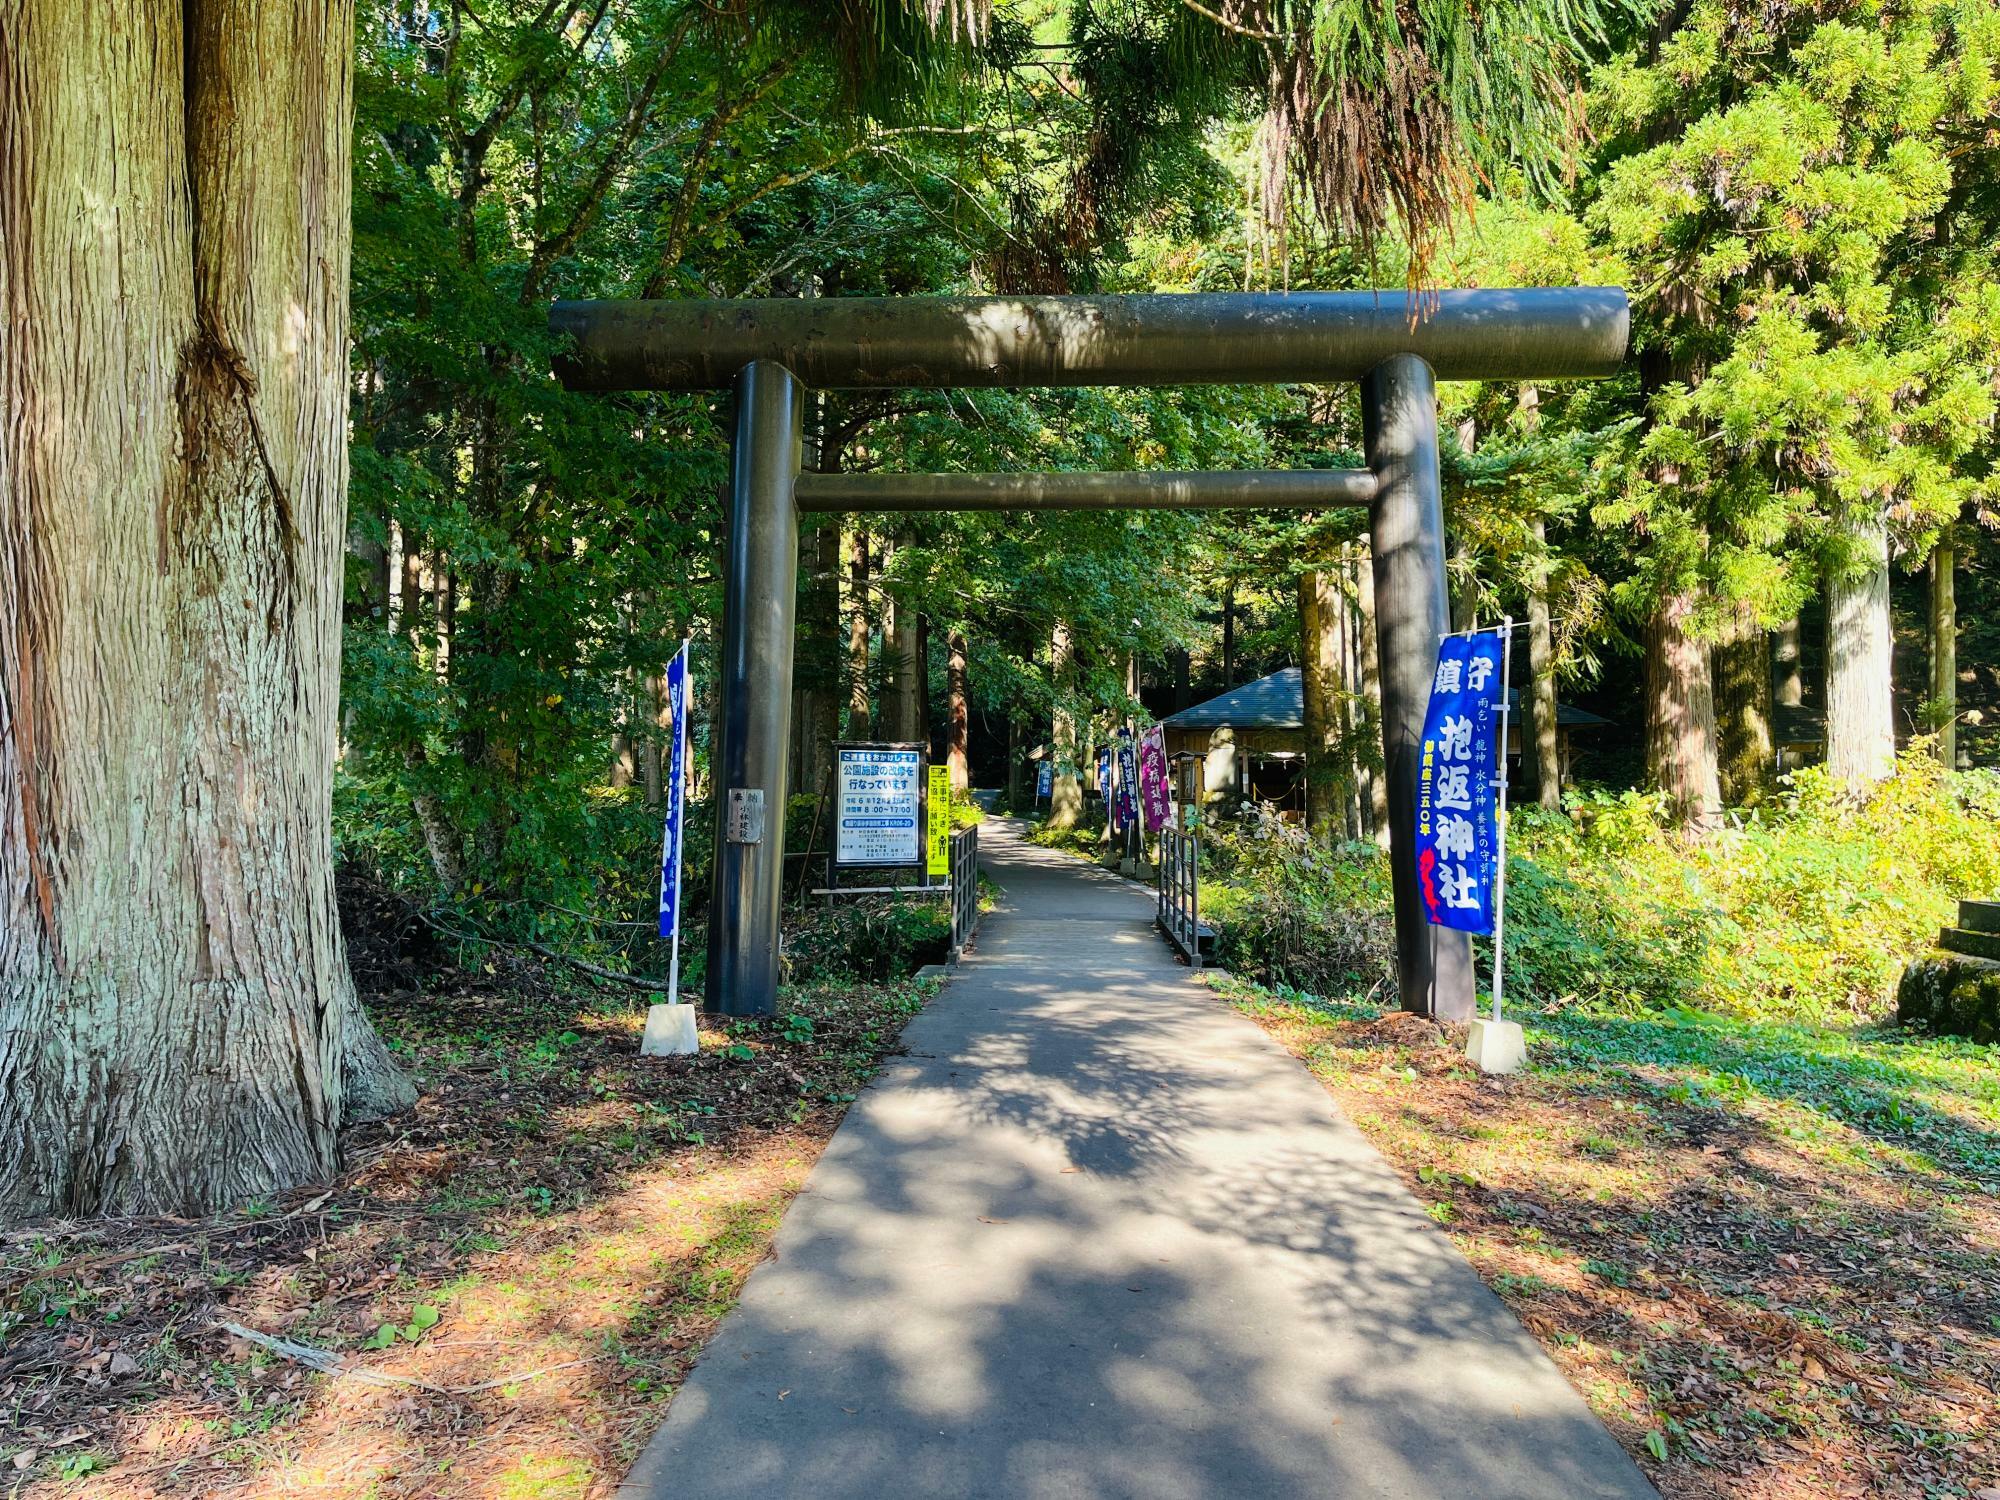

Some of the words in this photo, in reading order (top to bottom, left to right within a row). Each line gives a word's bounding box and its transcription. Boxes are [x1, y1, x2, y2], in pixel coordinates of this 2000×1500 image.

[1476, 697, 1489, 731] 雨乞い
[843, 765, 914, 776] 公園施設の改修を
[849, 779, 909, 790] 行なっています
[1434, 714, 1480, 910] 抱返神社
